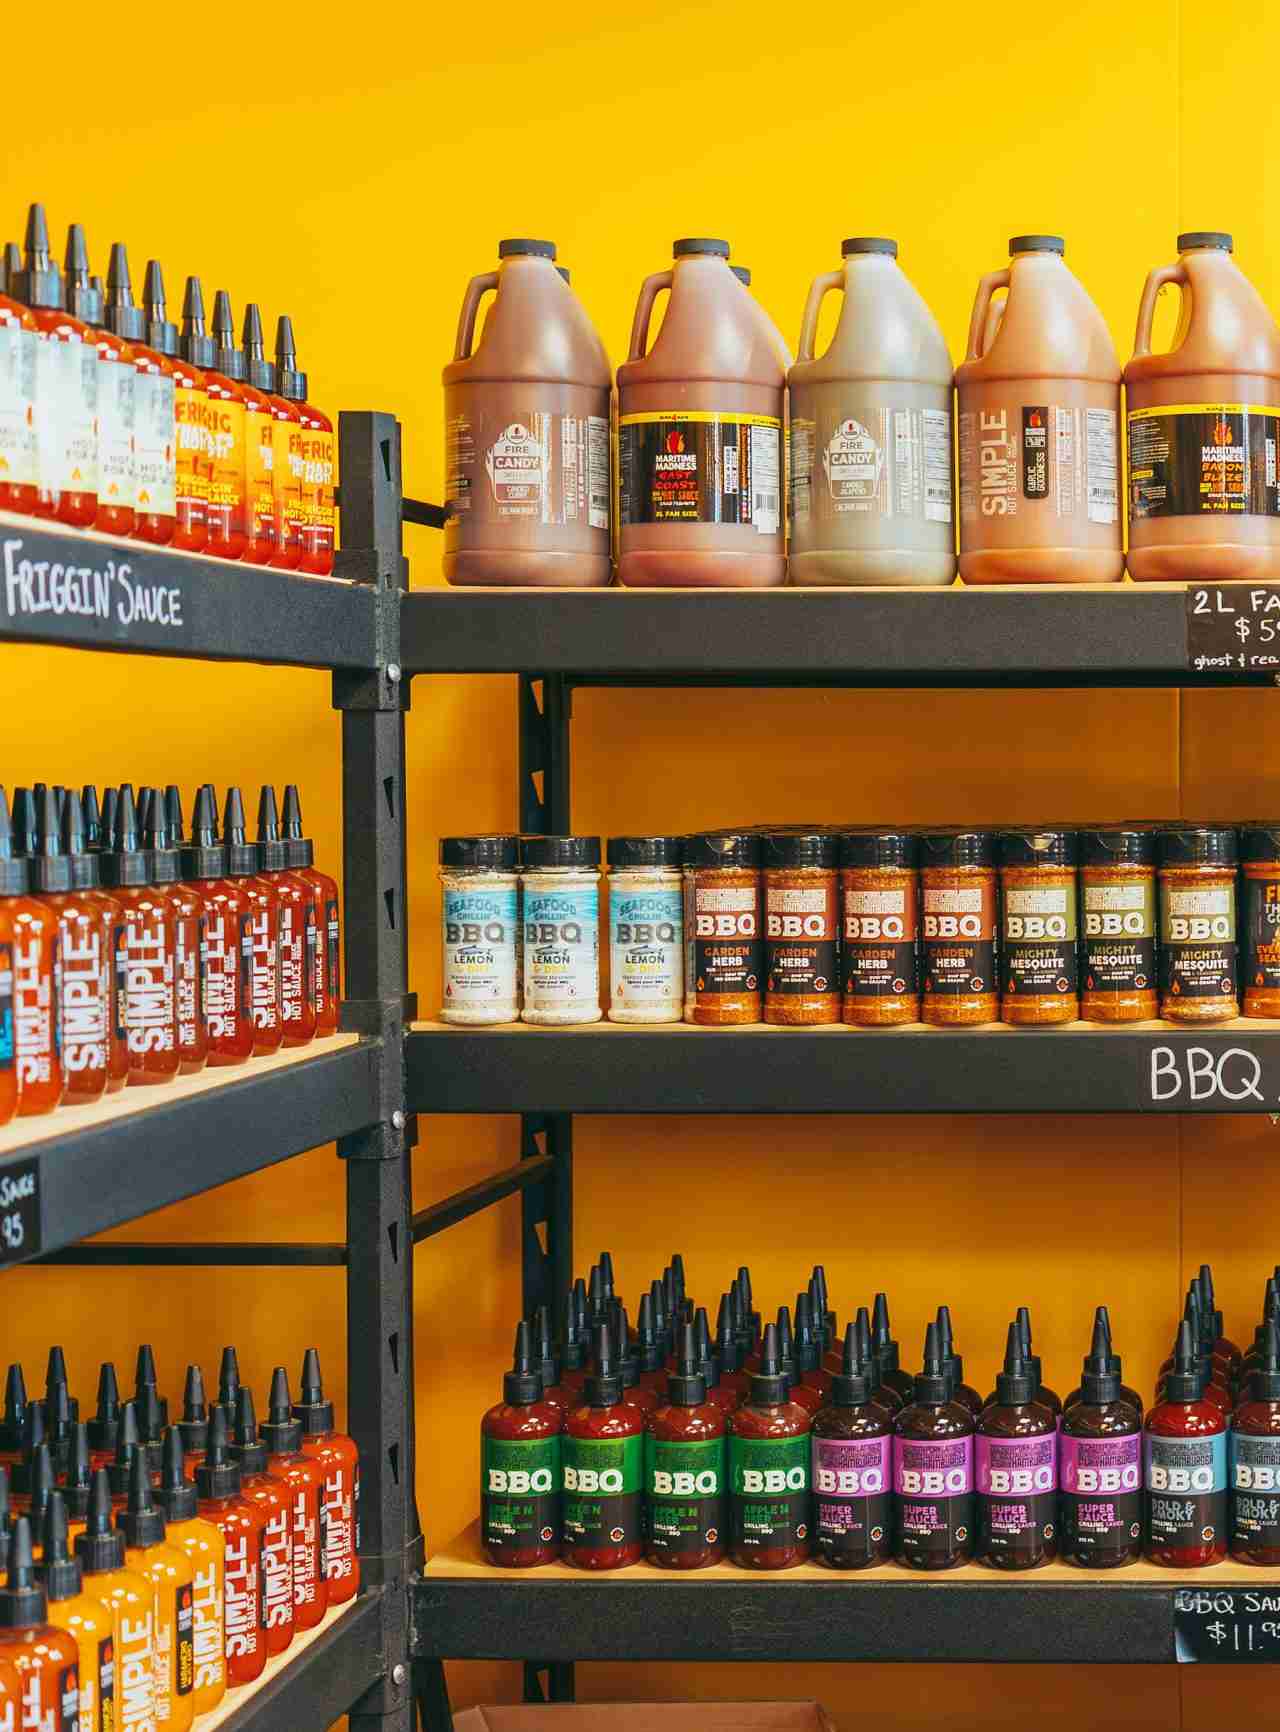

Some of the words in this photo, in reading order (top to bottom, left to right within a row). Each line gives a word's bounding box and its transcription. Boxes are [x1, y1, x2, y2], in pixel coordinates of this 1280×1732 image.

[496, 458, 538, 468] CANDY
[832, 453, 872, 464] CANDY
[981, 409, 1008, 515] SIMPLE
[117, 565, 183, 626] SAUCE
[1194, 653, 1232, 669] ghost
[696, 914, 755, 935] BBQ
[768, 915, 825, 937] BBQ
[847, 917, 903, 939] BBQ
[924, 915, 981, 937] BBQ
[1007, 916, 1066, 938] BBQ
[1086, 912, 1144, 934] BBQ
[1171, 916, 1229, 940] BBQ
[446, 923, 504, 943] BBQ
[526, 923, 581, 943] BBQ
[616, 923, 674, 943] BBQ
[1016, 949, 1057, 958] MIGHTY
[1095, 945, 1135, 954] MIGHTY
[454, 955, 493, 963] LEMON
[533, 955, 570, 963] LEMON
[625, 955, 664, 963] LEMON
[1089, 955, 1142, 965] MESQUITE
[1181, 951, 1222, 960] MIGHTY
[713, 957, 742, 966] HERB
[780, 957, 808, 967] HERB
[858, 959, 888, 969] HERB
[936, 958, 965, 968] HERB
[1011, 959, 1064, 969] MESQUITE
[1175, 960, 1228, 969] MESQUITE
[1152, 1046, 1264, 1101] BBQ
[489, 1468, 552, 1492] BBQ
[564, 1468, 623, 1492] BBQ
[654, 1471, 717, 1494] BBQ
[743, 1468, 805, 1492] BBQ
[817, 1468, 882, 1492] BBQ
[903, 1468, 966, 1493] BBQ
[991, 1467, 1052, 1492] BBQ
[1077, 1466, 1138, 1492] BBQ
[1151, 1467, 1215, 1490] BBQ
[821, 1505, 851, 1514] SUPER
[904, 1505, 936, 1515] SUPER
[991, 1505, 1025, 1514] SUPER
[1078, 1504, 1113, 1513] SUPER
[1152, 1500, 1182, 1511] BOLD
[1236, 1499, 1267, 1510] BOLD
[821, 1514, 851, 1522] SAUCE
[904, 1514, 936, 1522] SAUCE
[991, 1514, 1025, 1522] SAUCE
[1078, 1513, 1115, 1521] SAUCE
[1152, 1509, 1193, 1520] SMOKY
[1236, 1509, 1278, 1519] SMOKY
[1175, 1591, 1235, 1614] BBQ
